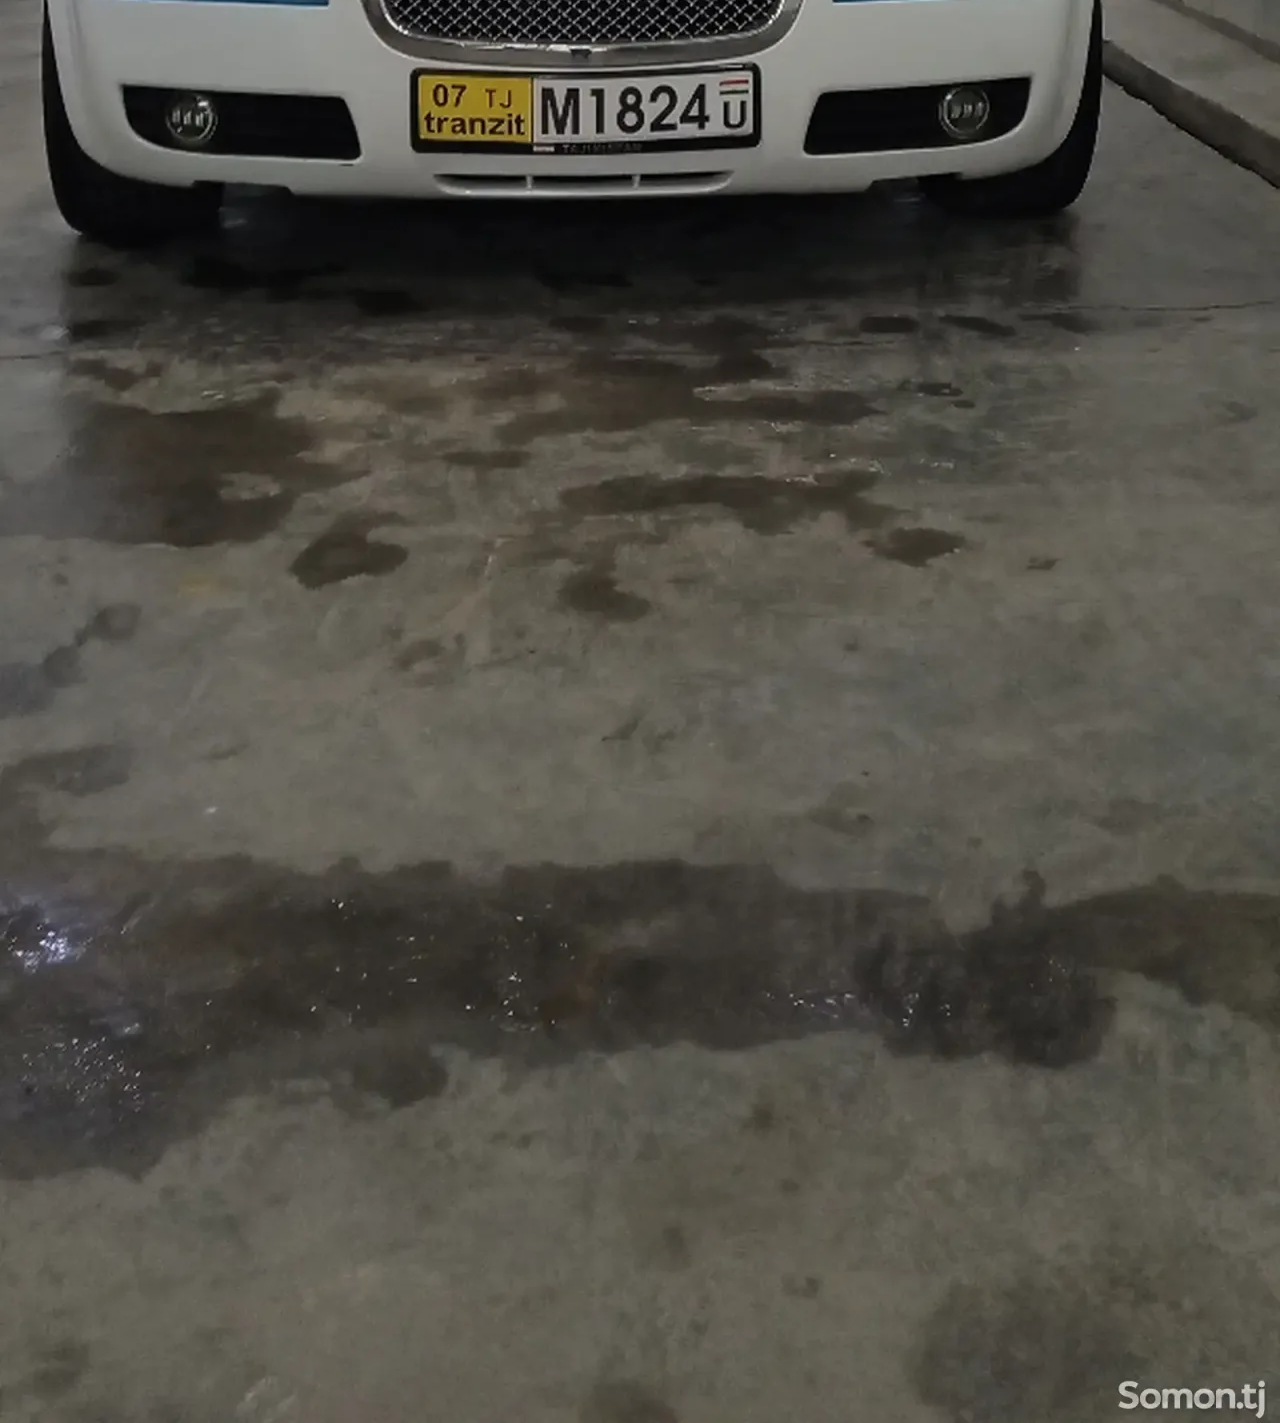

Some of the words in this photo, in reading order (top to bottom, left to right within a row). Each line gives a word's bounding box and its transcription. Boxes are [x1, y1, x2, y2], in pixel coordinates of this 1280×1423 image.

[433, 84, 467, 107] 07
[485, 88, 512, 108] TJ
[541, 83, 710, 135] M1824
[424, 110, 526, 135] tranzit
[723, 100, 747, 129] U
